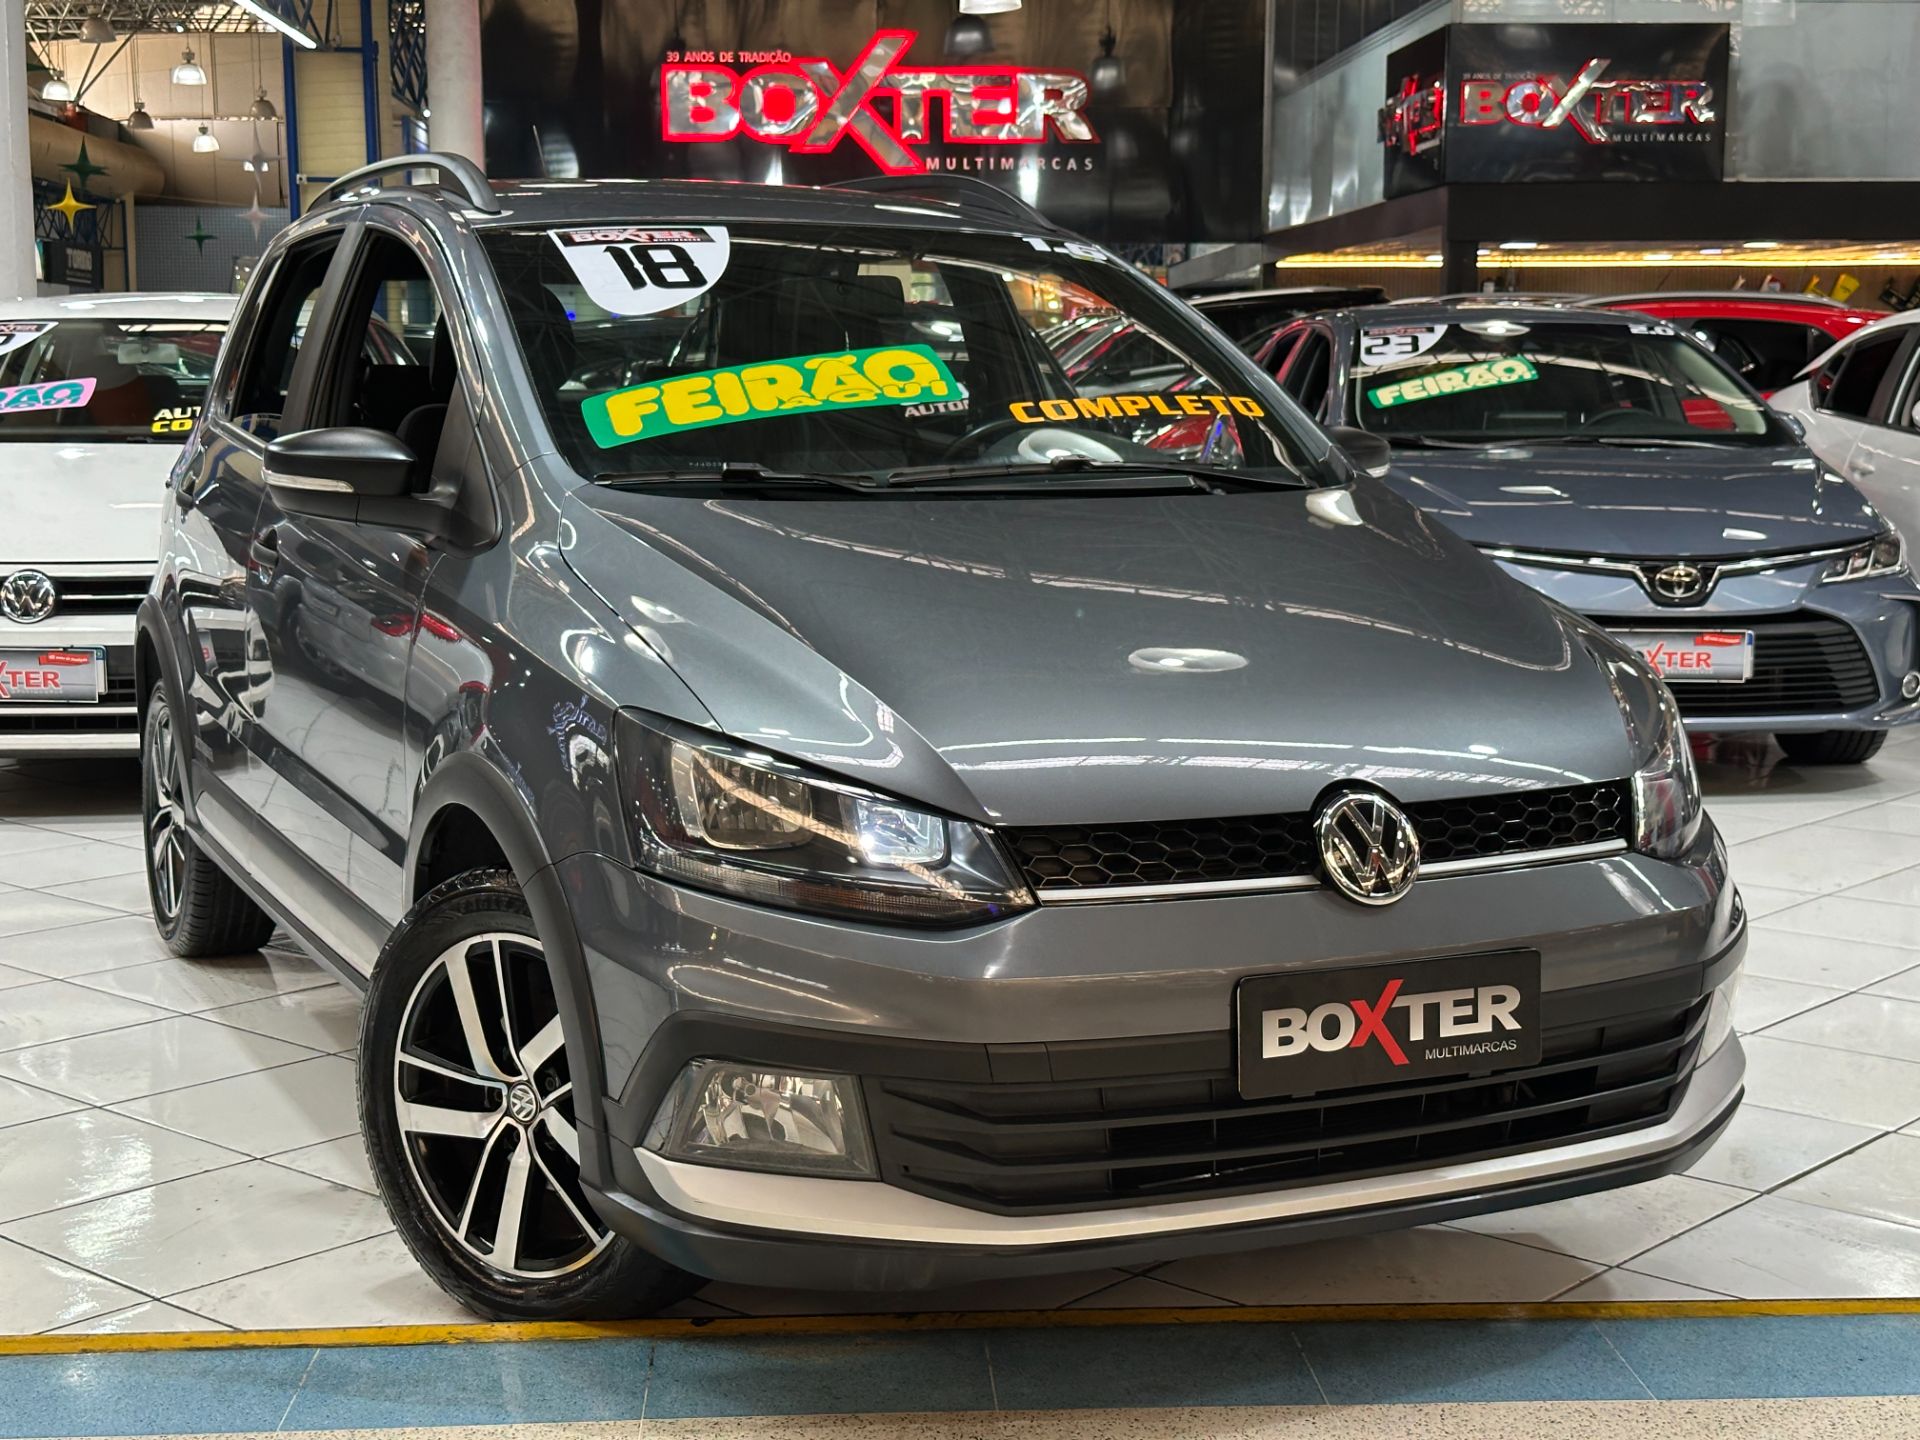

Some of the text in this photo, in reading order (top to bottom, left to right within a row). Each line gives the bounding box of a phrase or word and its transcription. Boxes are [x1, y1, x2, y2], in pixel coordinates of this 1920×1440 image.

[666, 49, 791, 65] 39 ANOS DE TRADIÇÃO
[661, 29, 1100, 176] BOXTER
[1461, 58, 1716, 144] BOXTER
[1611, 132, 1713, 142] MULTIMARCAS
[926, 157, 1093, 171] MULTIMARCAS
[568, 227, 697, 244] BOXTER
[603, 243, 709, 291] 18
[1364, 334, 1420, 356] 23
[604, 349, 941, 437] FEIRÃO
[1376, 358, 1530, 406] FEIRÃO
[1008, 394, 1265, 424] COMPLETO
[1262, 978, 1523, 1066] BOXTER
[1425, 1038, 1518, 1061] MULTIMARCAS
